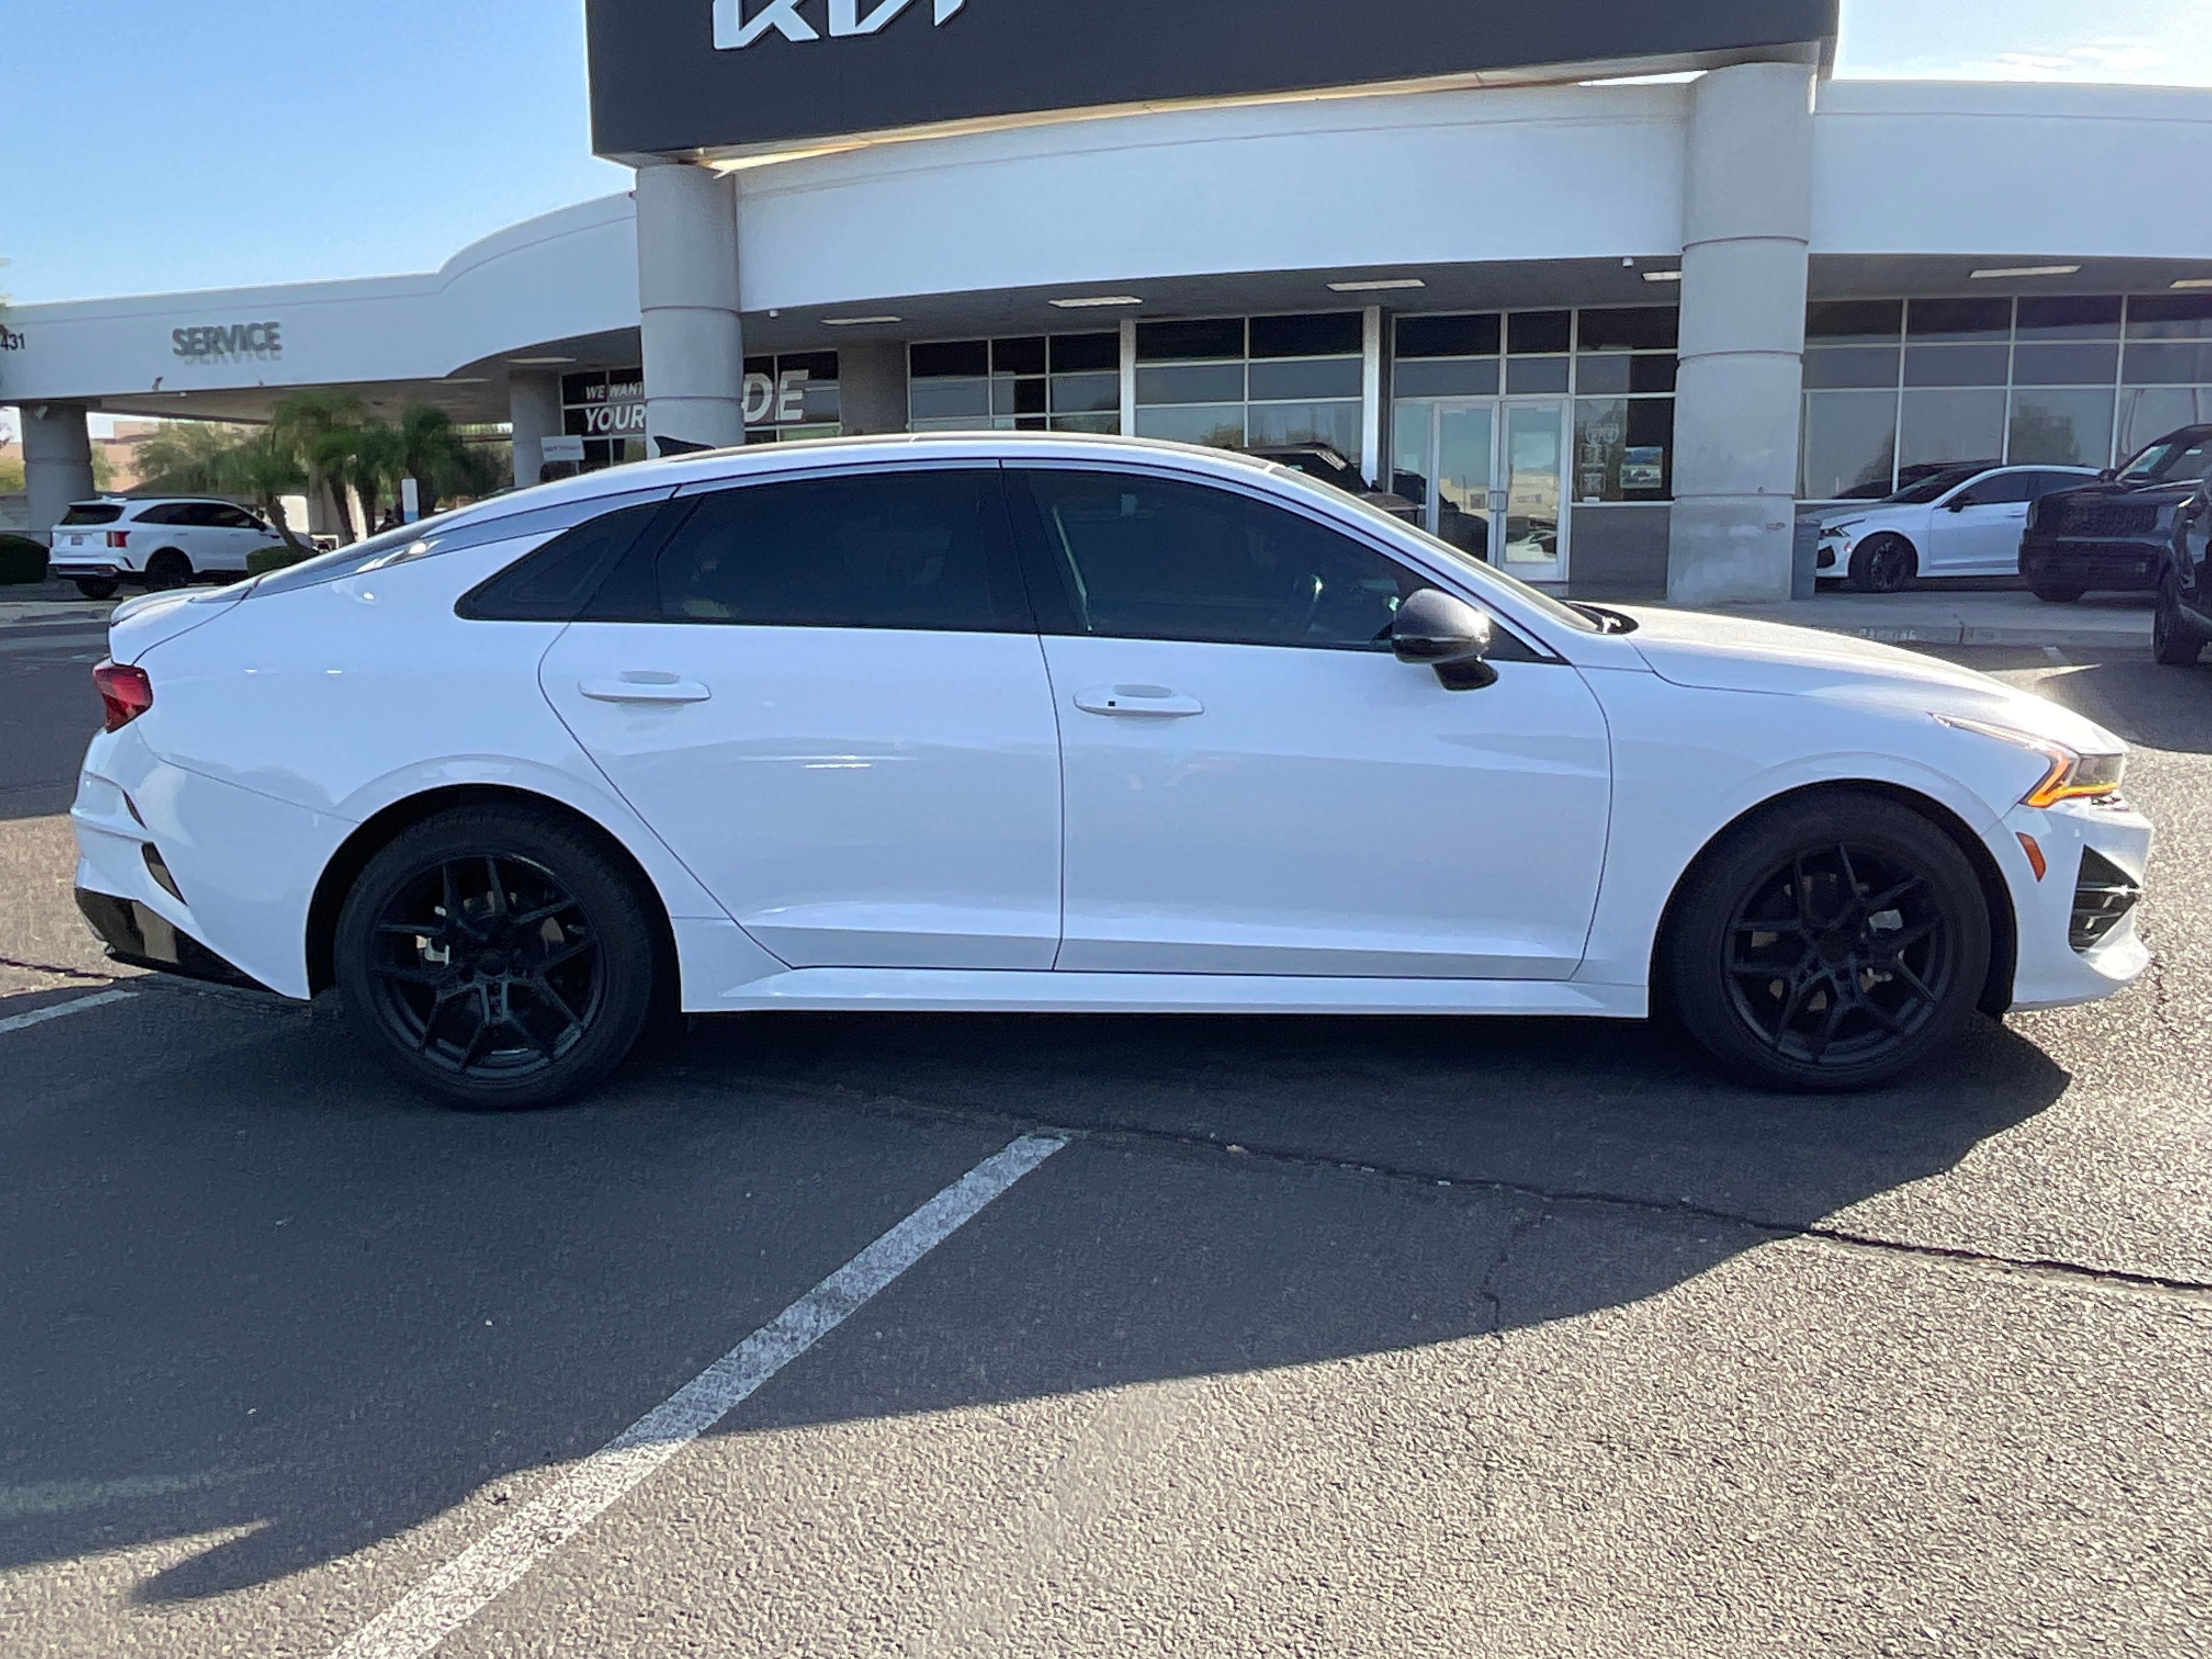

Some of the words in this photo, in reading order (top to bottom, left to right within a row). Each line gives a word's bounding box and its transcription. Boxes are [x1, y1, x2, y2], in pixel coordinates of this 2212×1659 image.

[172, 321, 283, 357] SERVICE
[586, 386, 606, 399] WE
[610, 382, 644, 397] WANT
[742, 369, 809, 422] DE
[585, 405, 645, 432] YOUR
